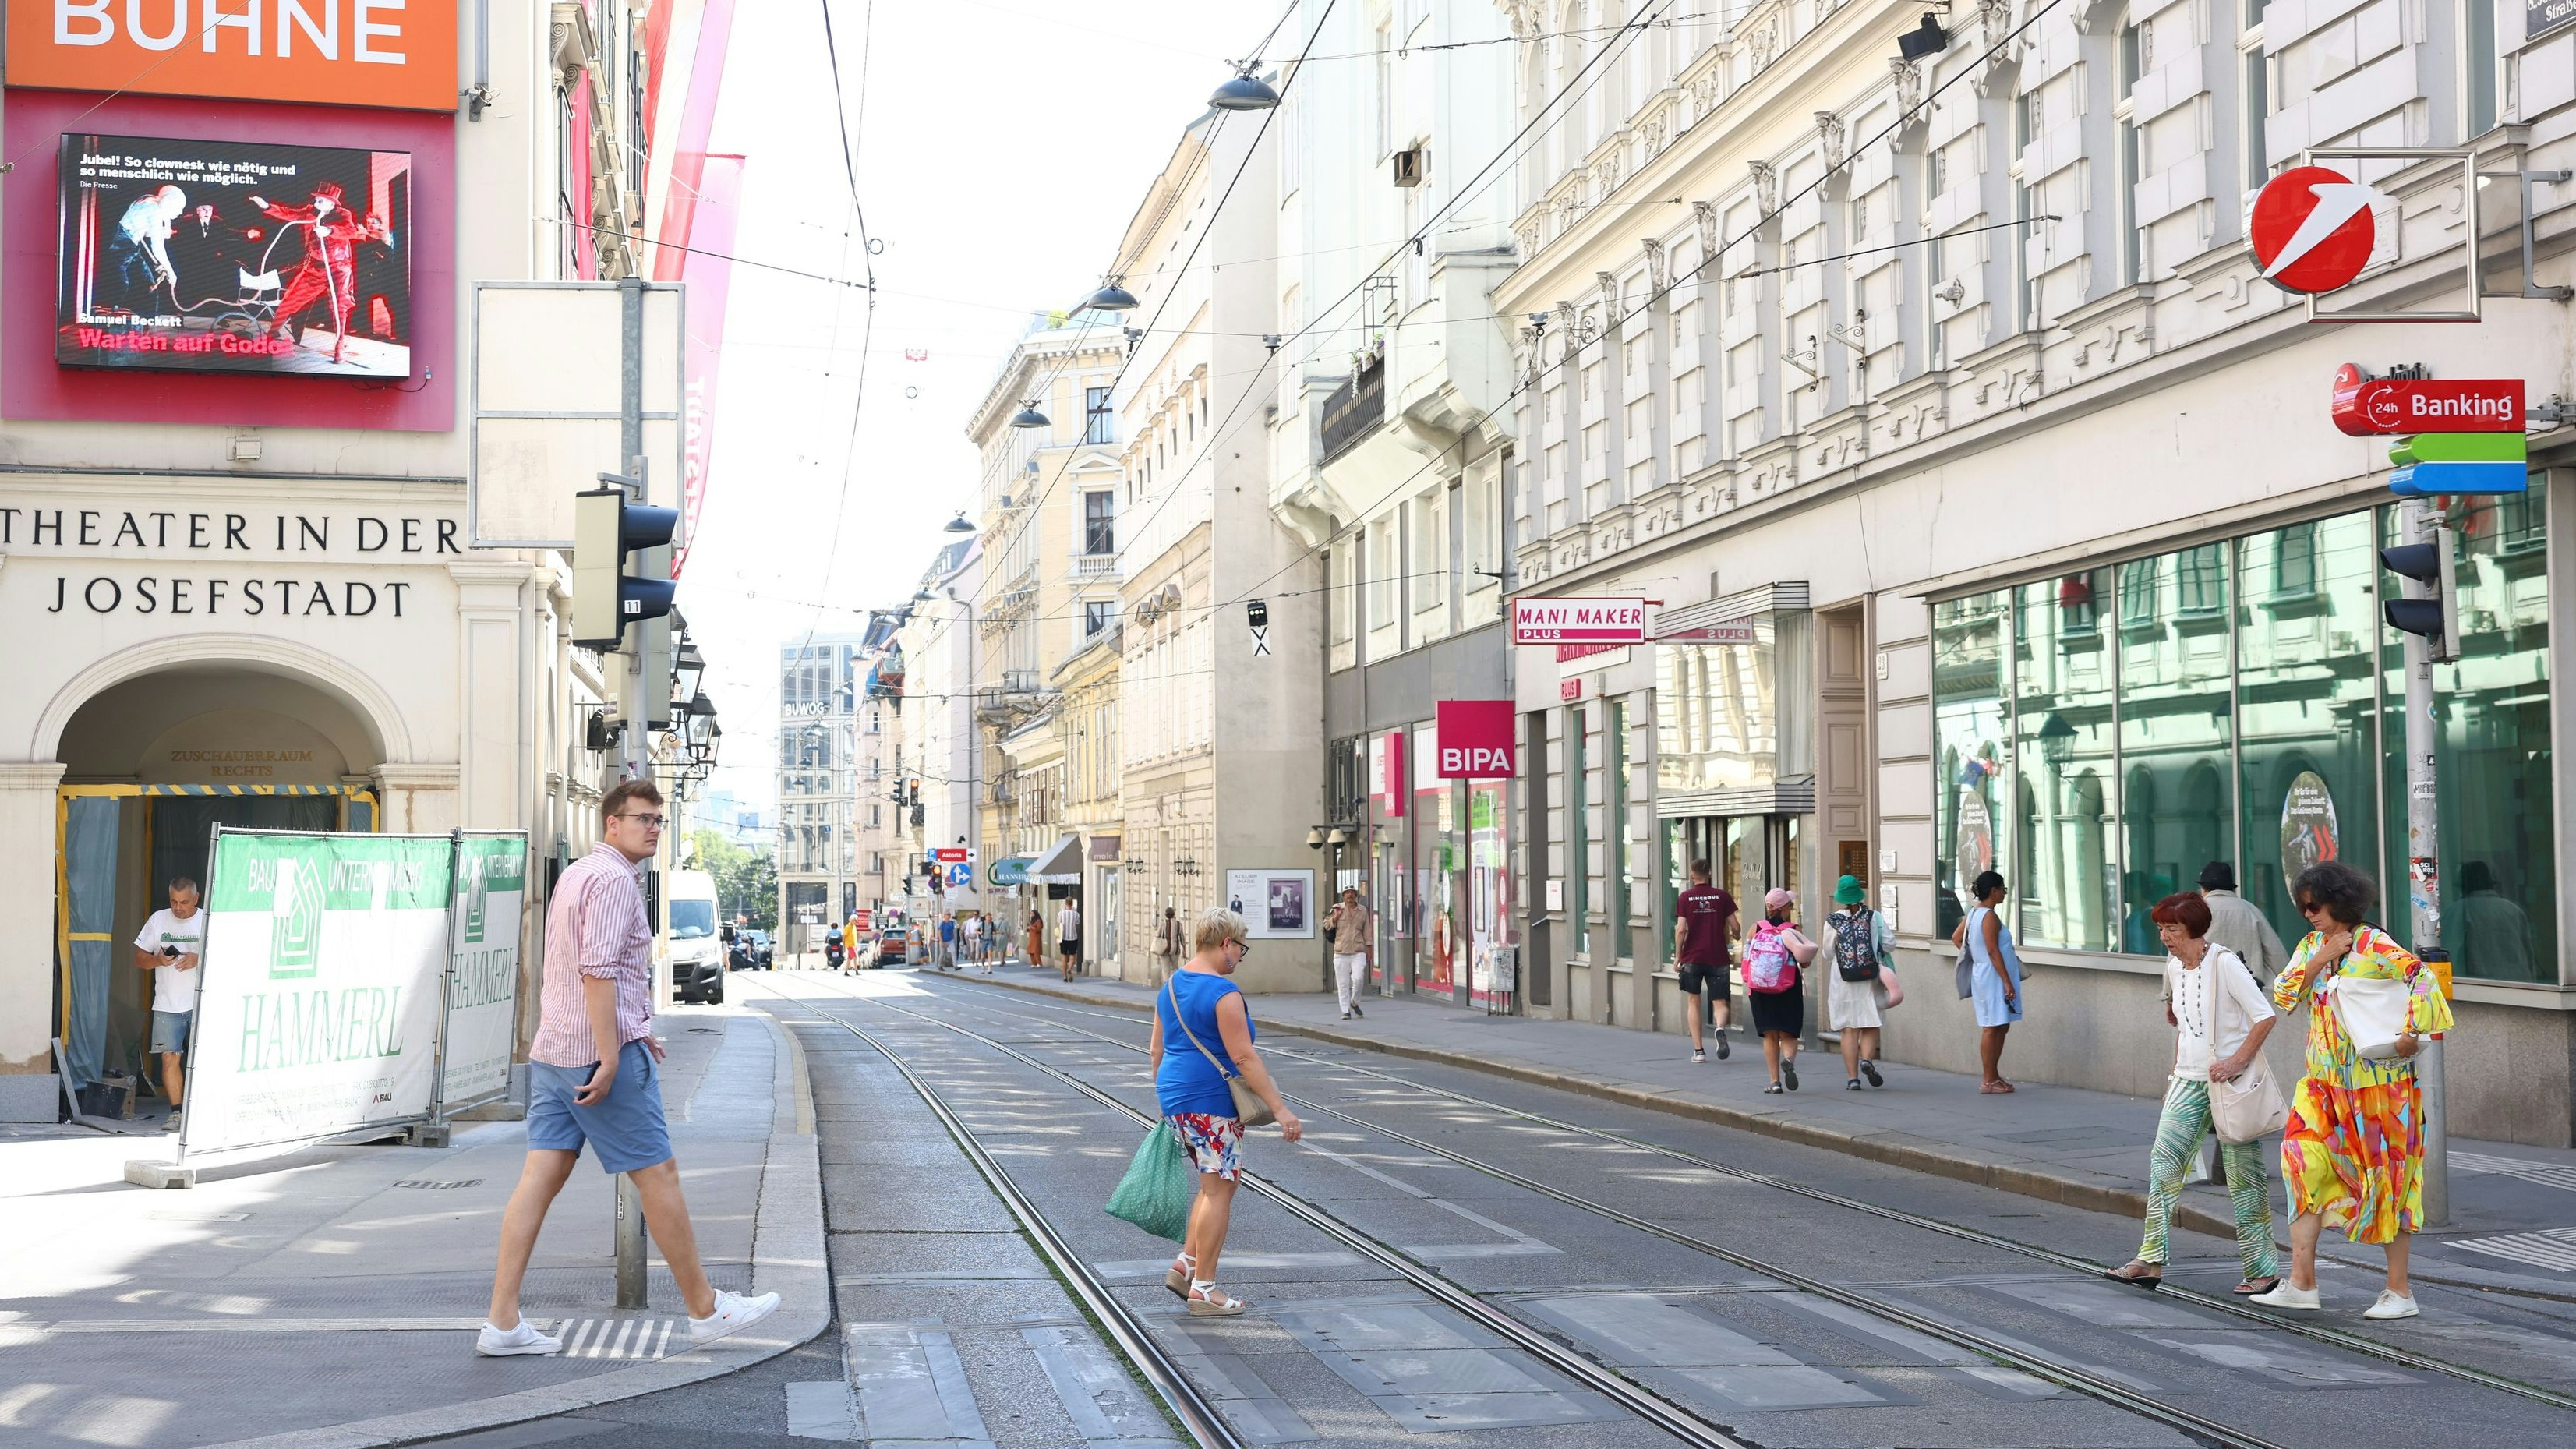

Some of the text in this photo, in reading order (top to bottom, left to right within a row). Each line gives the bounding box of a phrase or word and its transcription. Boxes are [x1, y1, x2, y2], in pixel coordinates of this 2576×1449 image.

[80, 154, 295, 176] Jubel! So clownesk wie nötig und
[80, 168, 258, 186] so menschlich wie möglich.
[79, 313, 182, 327] Samuel Beckett
[79, 327, 168, 352] Warten
[173, 331, 216, 352] auf
[2376, 403, 2398, 413] 24h
[2412, 393, 2513, 422] Banking
[0, 508, 461, 554] THEATER IN DER
[48, 577, 411, 617] JOSEFSTADT
[627, 601, 639, 612] 11
[1518, 609, 1641, 624] MANI MAKER
[1523, 629, 1561, 639] PLUS
[1561, 680, 1574, 698] PLUS
[785, 702, 825, 716] BUWOG
[171, 751, 313, 762] ZUSCHAUERRAUM
[1443, 747, 1511, 772] BIPA
[211, 765, 273, 776] RECHTS
[451, 948, 513, 1011] HAMMERL
[236, 985, 405, 1073] HAMMERL
